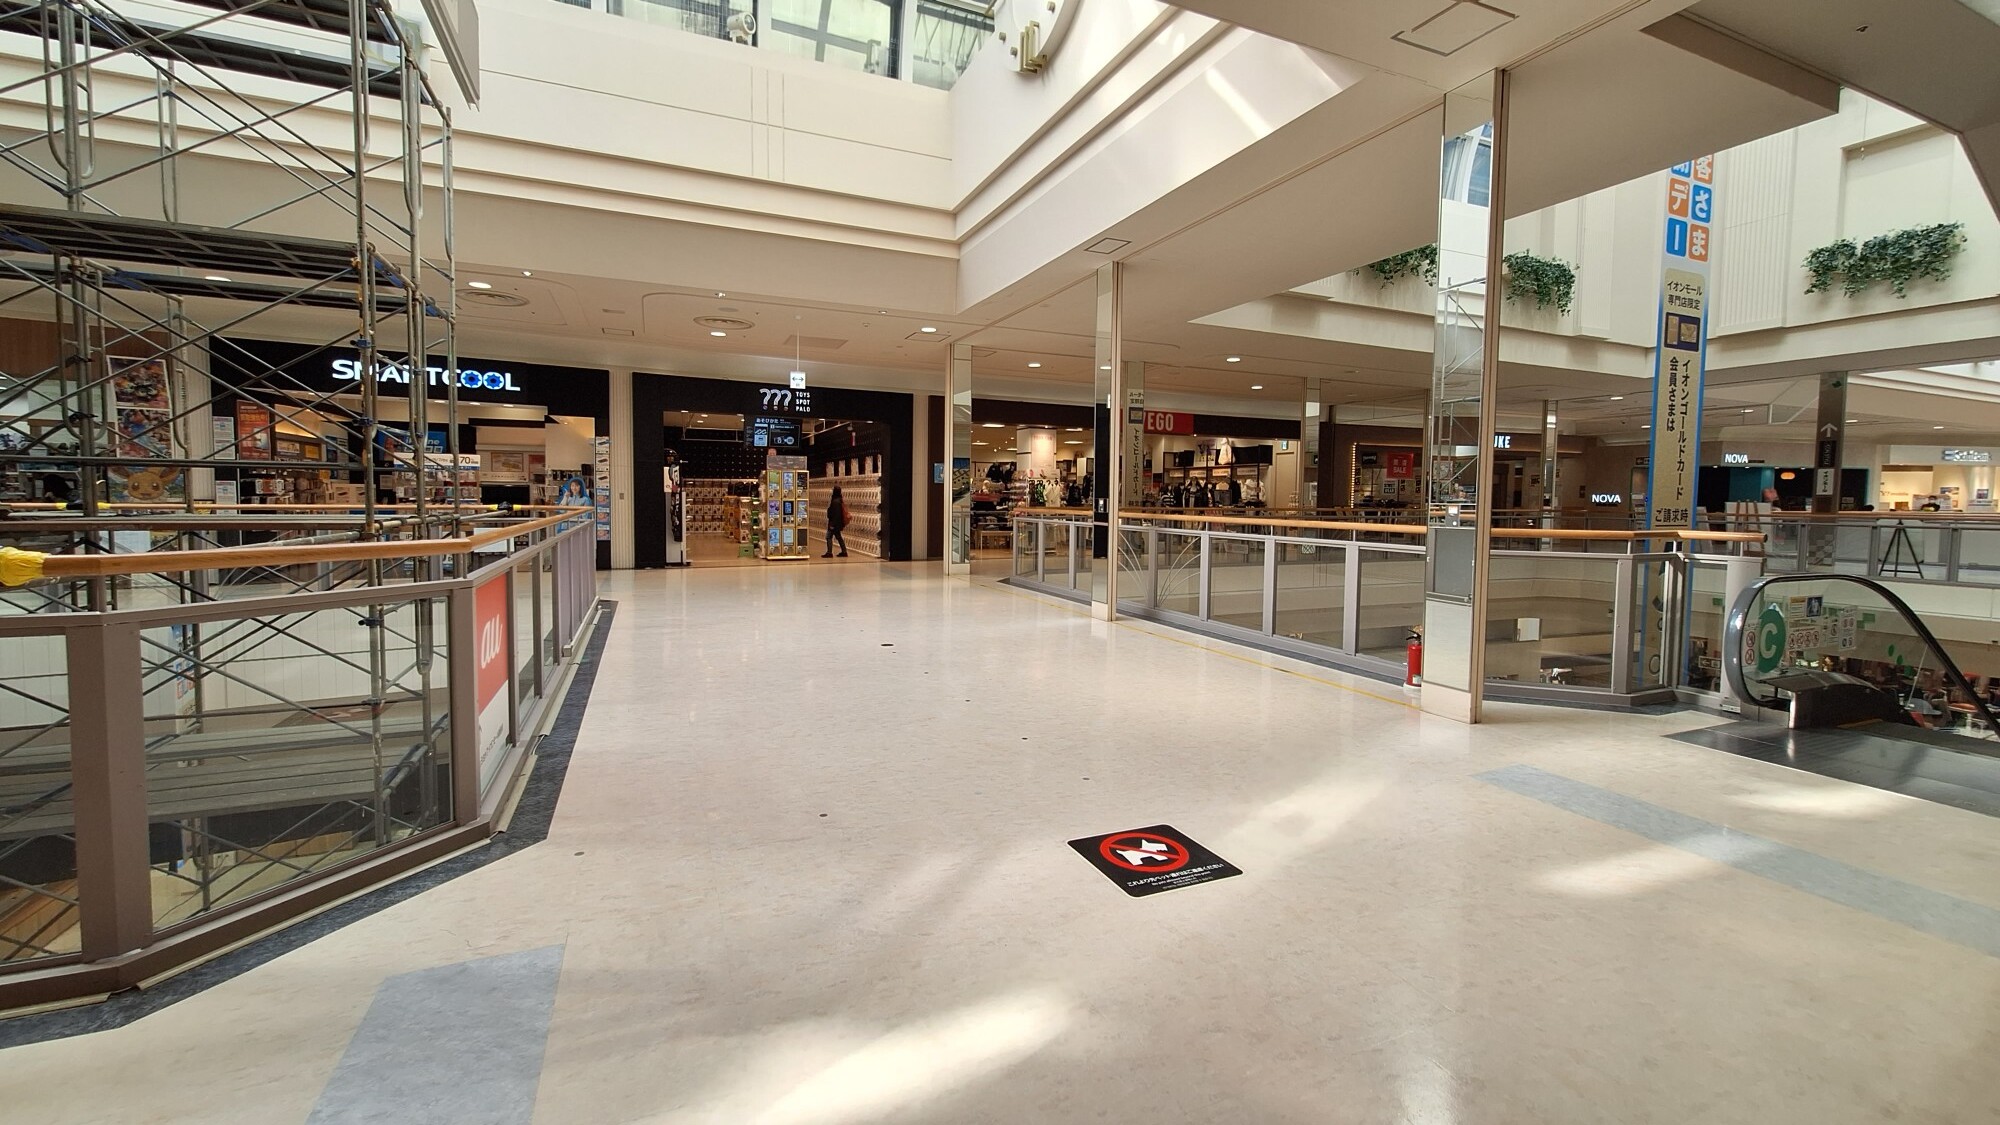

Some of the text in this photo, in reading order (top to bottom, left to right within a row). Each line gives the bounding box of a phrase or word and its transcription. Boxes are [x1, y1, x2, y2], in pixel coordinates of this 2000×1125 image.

[1667, 281, 1703, 296] イオンモール
[1668, 295, 1701, 310] 専門店限定
[1666, 356, 1679, 432] 会員さまは
[1676, 359, 1691, 501] イオンゴールドカード
[1725, 453, 1749, 464] NOVA
[1591, 494, 1621, 503] NOVA
[1655, 508, 1689, 523] ご請求時
[480, 613, 503, 669] au
[1760, 622, 1778, 659] C
